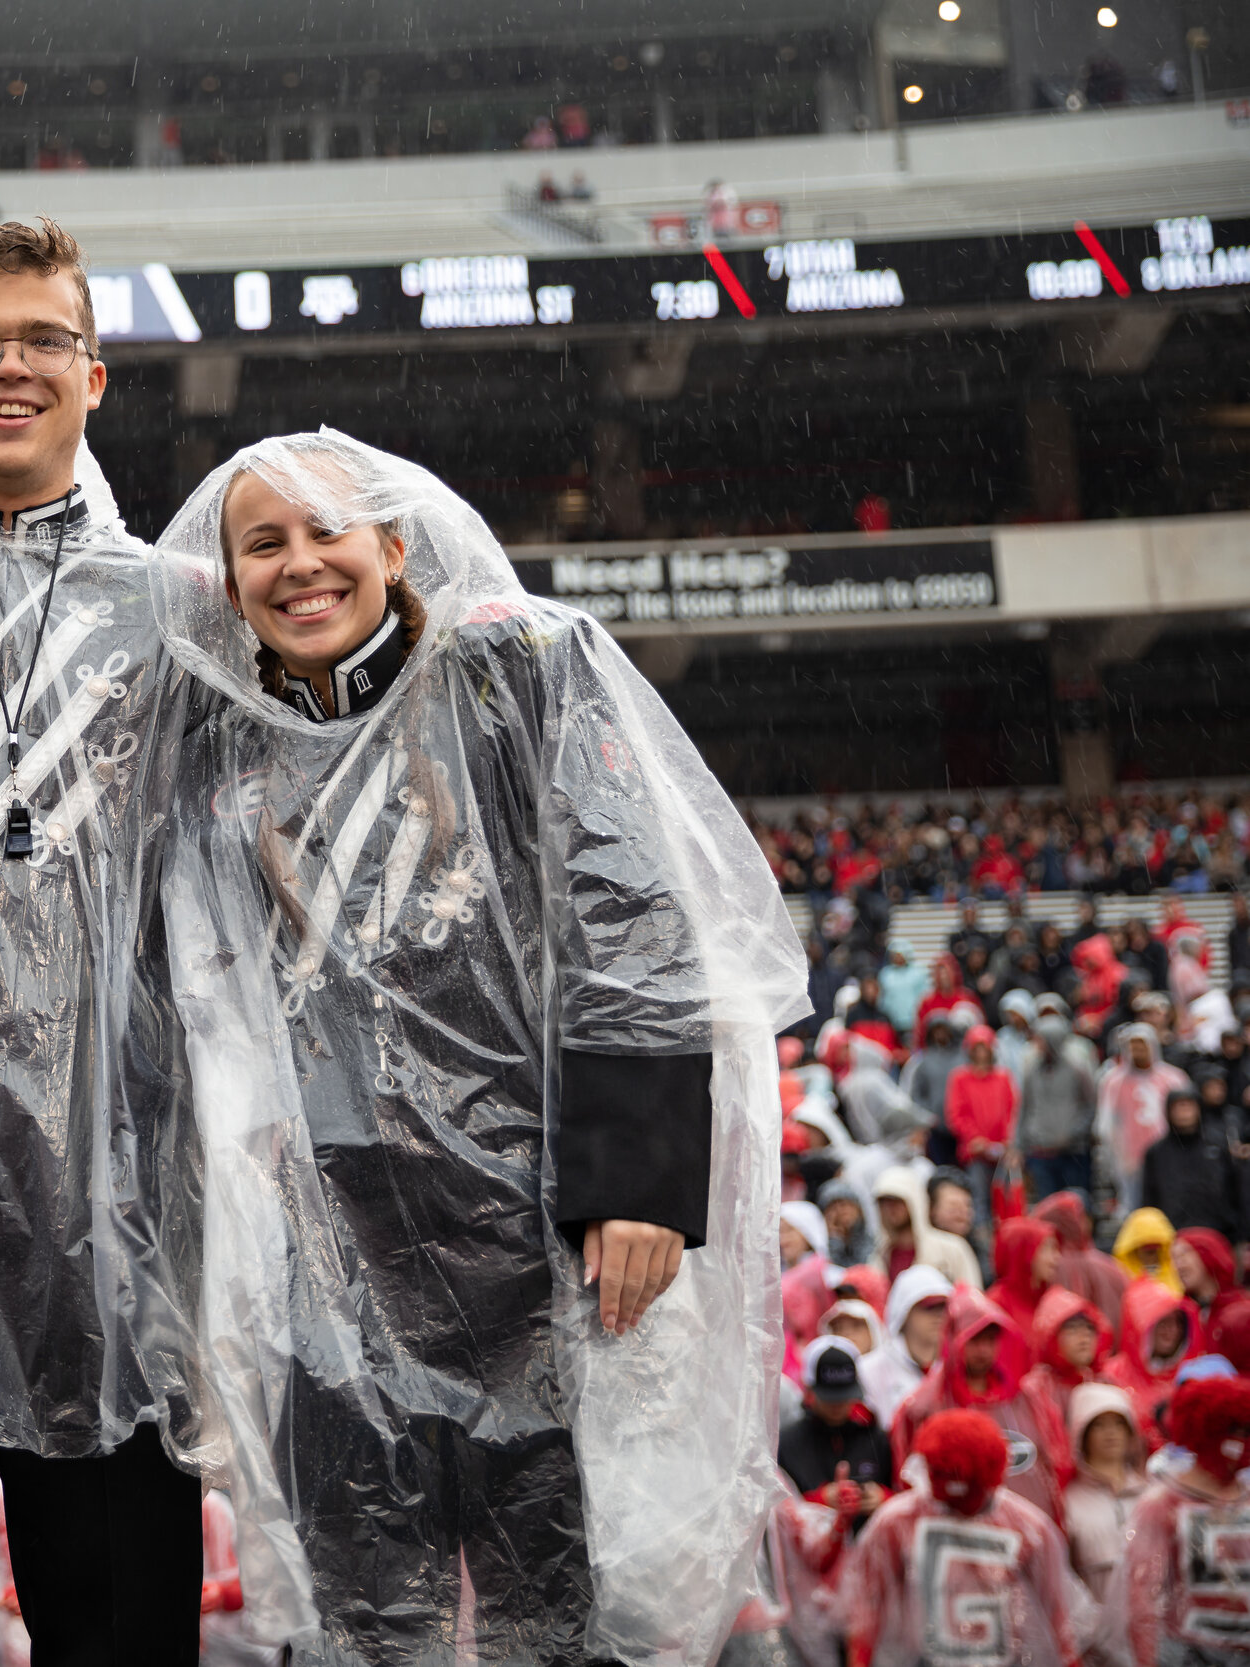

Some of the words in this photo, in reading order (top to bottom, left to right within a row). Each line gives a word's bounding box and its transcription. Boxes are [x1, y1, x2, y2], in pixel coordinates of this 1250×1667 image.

[764, 246, 784, 281] 7
[234, 271, 271, 330] 0
[536, 285, 576, 324] ST
[786, 268, 905, 312] ARIZONA
[552, 551, 663, 594] Need
[668, 547, 791, 592] Help?
[786, 577, 885, 615] location
[885, 577, 914, 609] to
[913, 1518, 1022, 1667] G
